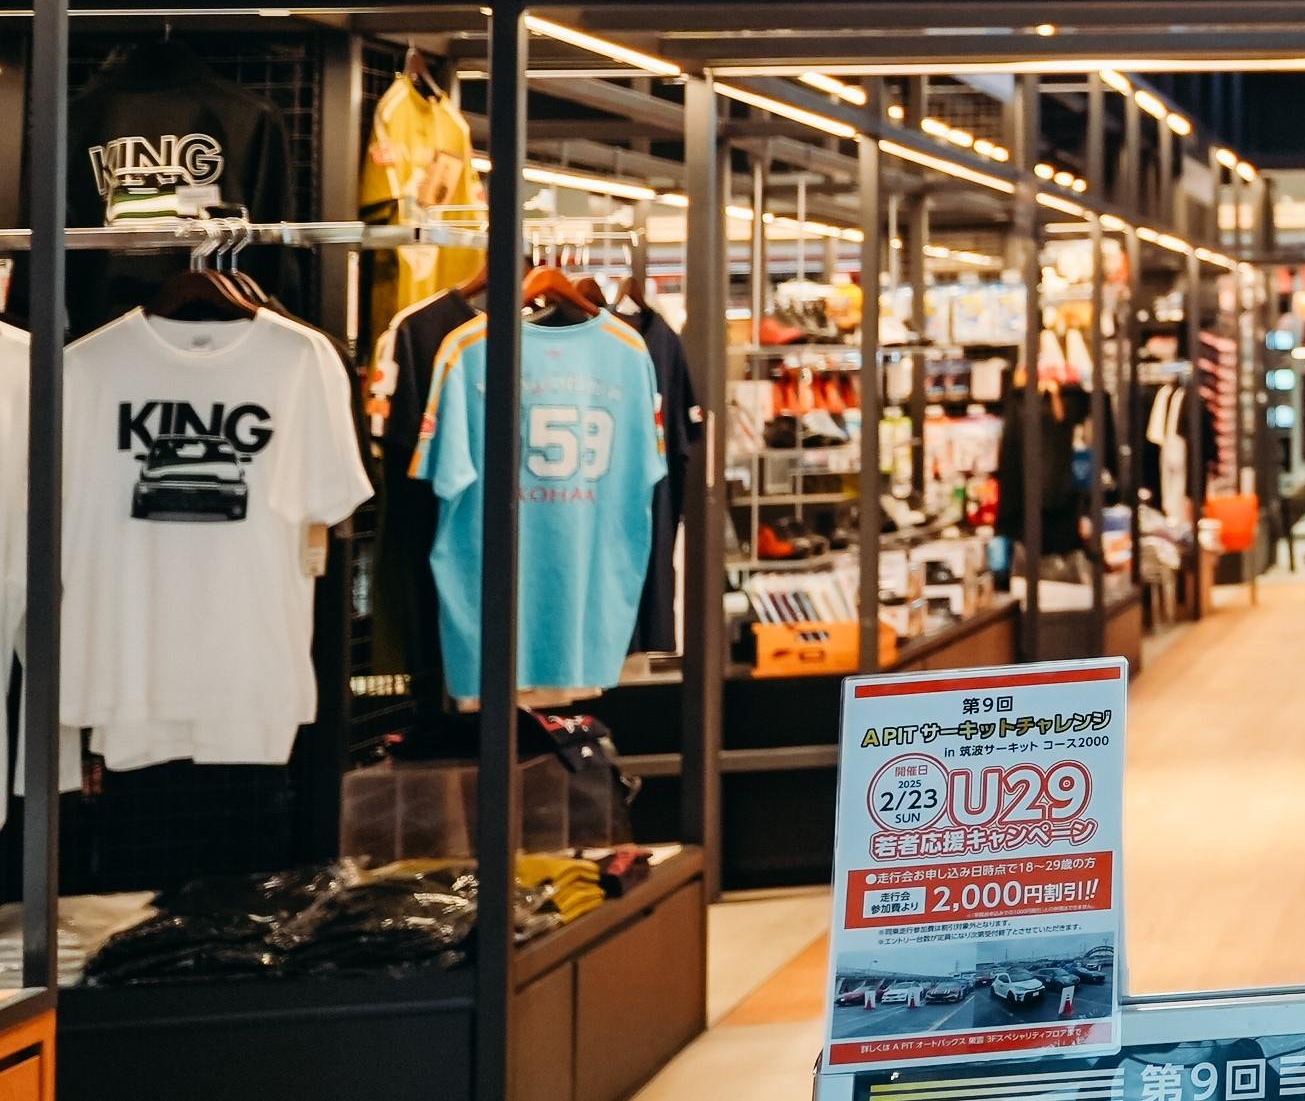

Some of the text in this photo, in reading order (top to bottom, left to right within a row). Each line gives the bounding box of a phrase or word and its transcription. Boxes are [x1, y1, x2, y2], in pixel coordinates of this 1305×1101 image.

[89, 133, 224, 195] KING
[118, 400, 274, 454] KING
[963, 696, 1014, 715] 第9回
[894, 765, 928, 777] 開催日
[898, 779, 922, 789] 2025
[948, 761, 1092, 827] U29
[879, 788, 938, 812] 2/23
[895, 812, 921, 824] SUN
[872, 819, 1097, 859] 若者応援キャンペーン
[880, 891, 911, 902] 走行会
[871, 902, 919, 915] 参加費より
[1139, 1057, 1267, 1101] 第9回
